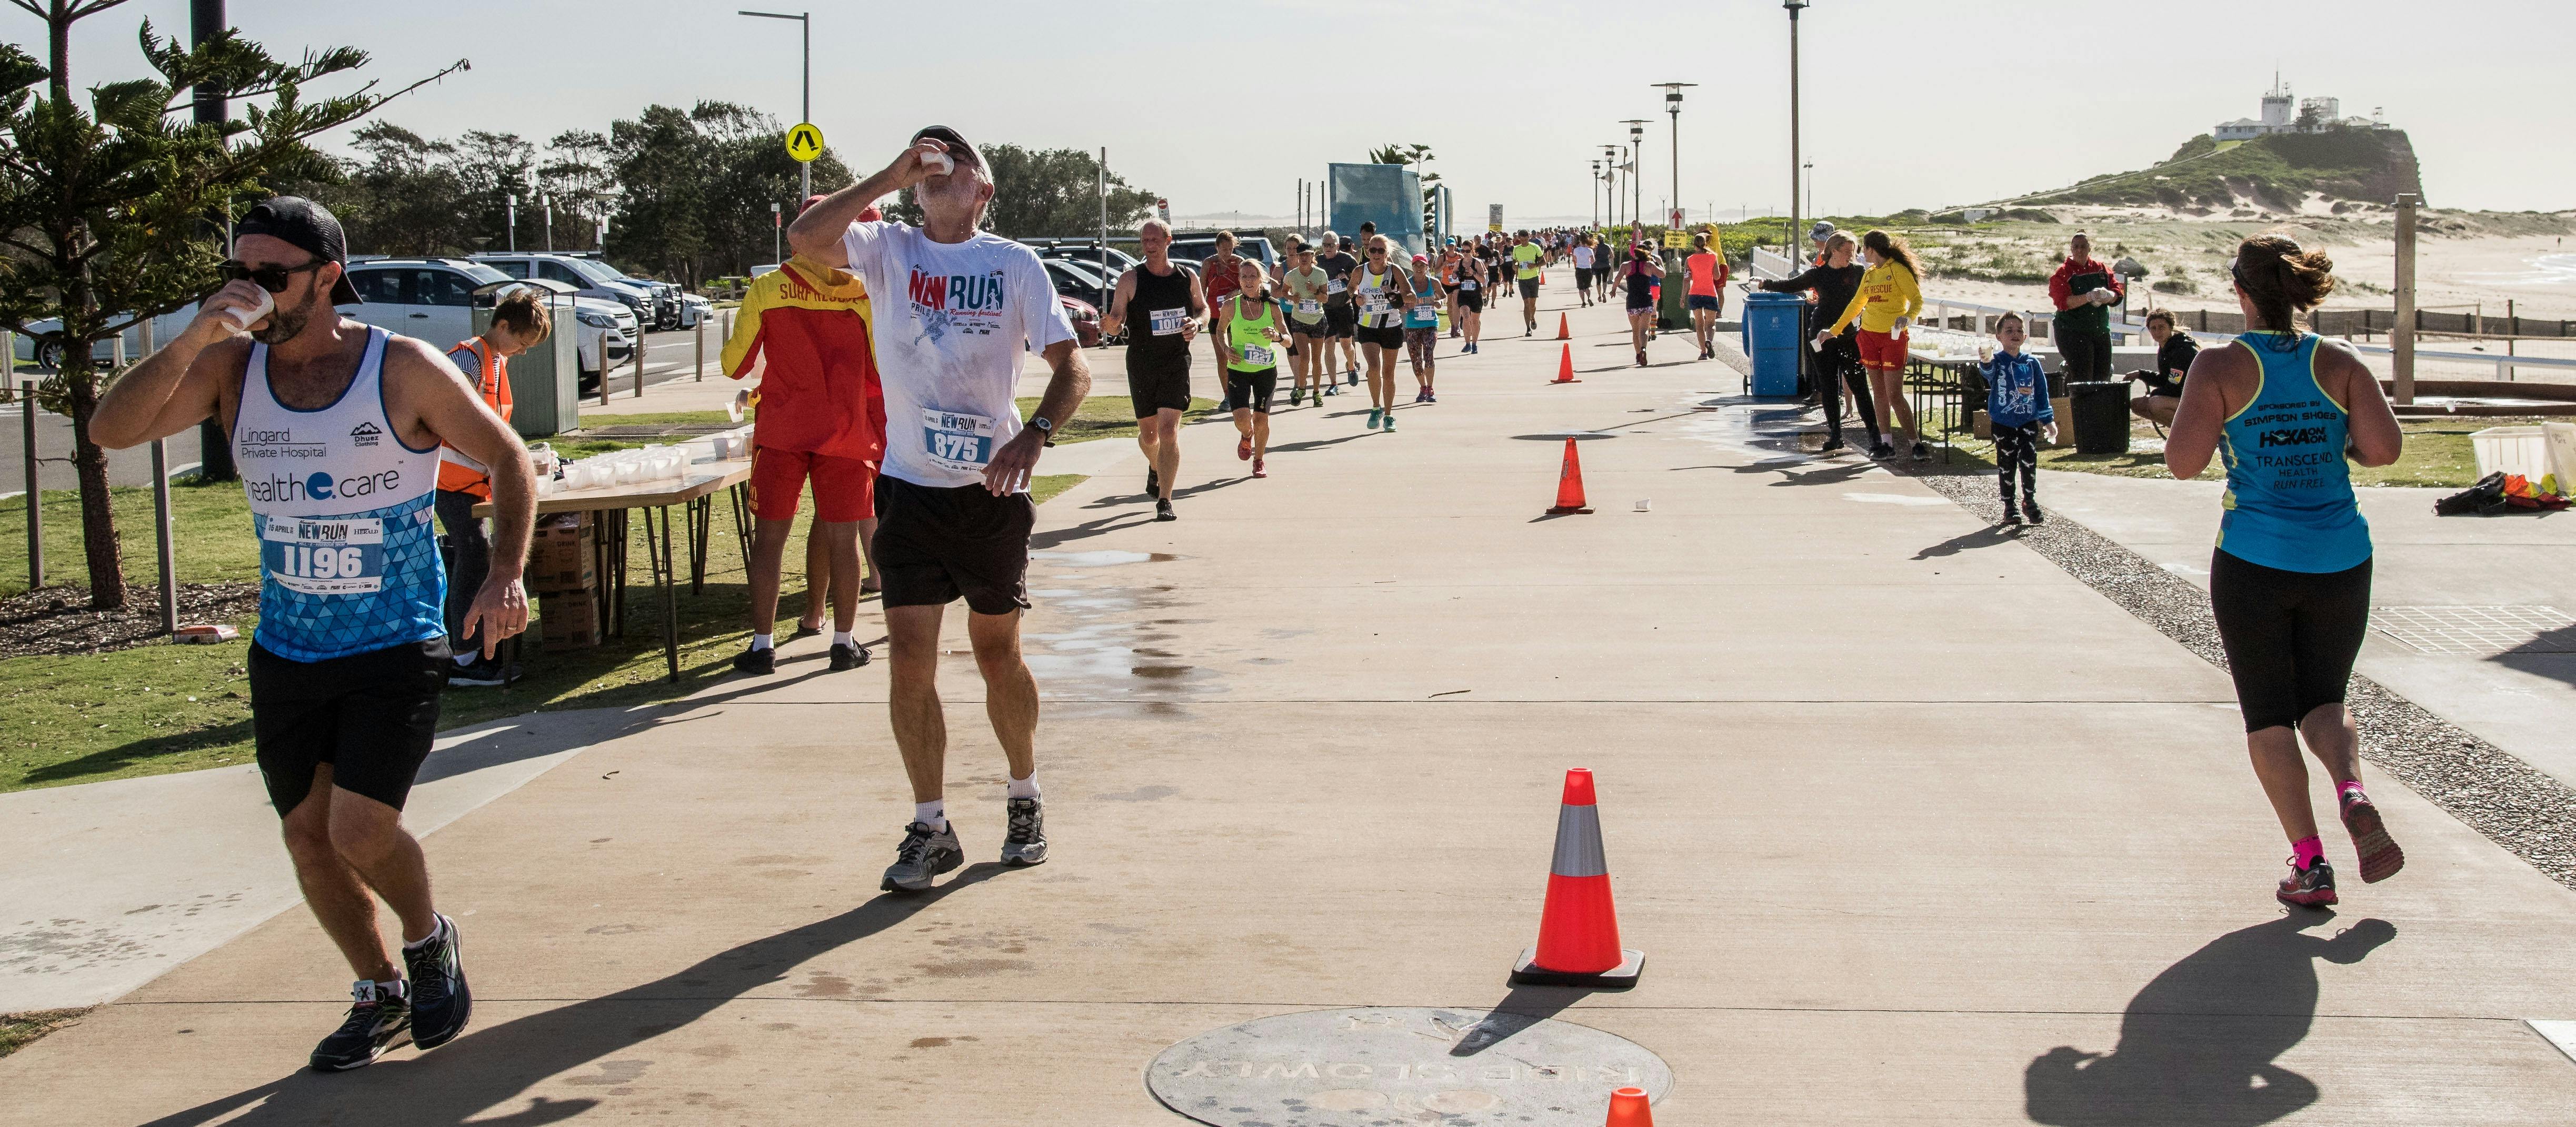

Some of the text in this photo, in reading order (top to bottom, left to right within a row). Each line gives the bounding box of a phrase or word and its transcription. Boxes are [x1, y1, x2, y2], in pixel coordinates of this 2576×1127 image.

[780, 283, 812, 302] SURF
[1870, 284, 1892, 293] RESCUE
[911, 303, 925, 315] PRIL
[950, 308, 1003, 317] Running festival
[1159, 317, 1182, 330] 1017
[1249, 351, 1271, 363] 1227
[2258, 402, 2307, 412] SPONSORED
[2244, 412, 2338, 427] SIMPSON SHOES
[241, 427, 290, 446] Lingard
[2259, 428, 2310, 448] HOKA
[242, 446, 326, 460] Private Hospital
[934, 433, 979, 462] 875
[2256, 452, 2333, 468] TRANSCEND
[2279, 468, 2318, 477] HEALTH
[2273, 478, 2325, 490] RUN FREE
[274, 525, 289, 534] APRIL
[284, 545, 362, 579] 1196
[1177, 1061, 1458, 1080] SLOWLY
